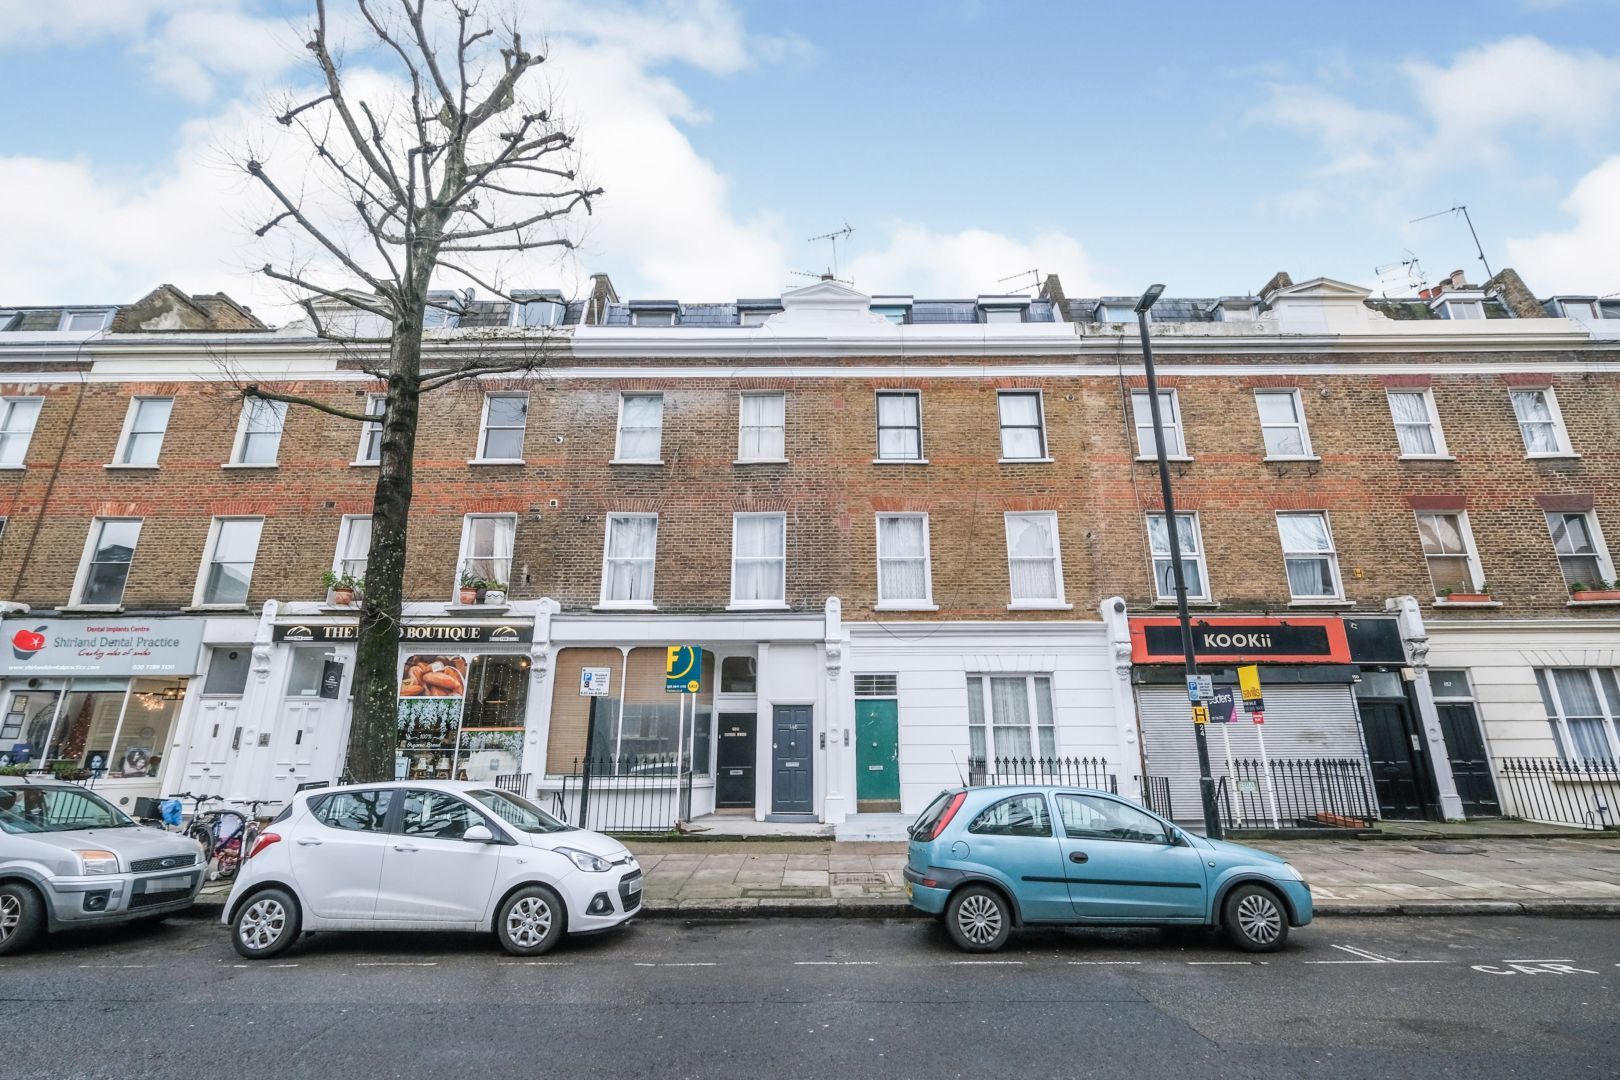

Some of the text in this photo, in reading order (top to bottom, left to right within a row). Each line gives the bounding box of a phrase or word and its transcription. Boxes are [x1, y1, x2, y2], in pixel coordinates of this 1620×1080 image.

[323, 626, 352, 638] THE
[406, 627, 480, 640] BOUTIQUE
[54, 636, 180, 648] Shirland Dental Practice
[1204, 633, 1272, 648] KOOKii
[1243, 687, 1260, 698] savills
[1194, 708, 1206, 722] H
[1470, 964, 1600, 976] CAR
